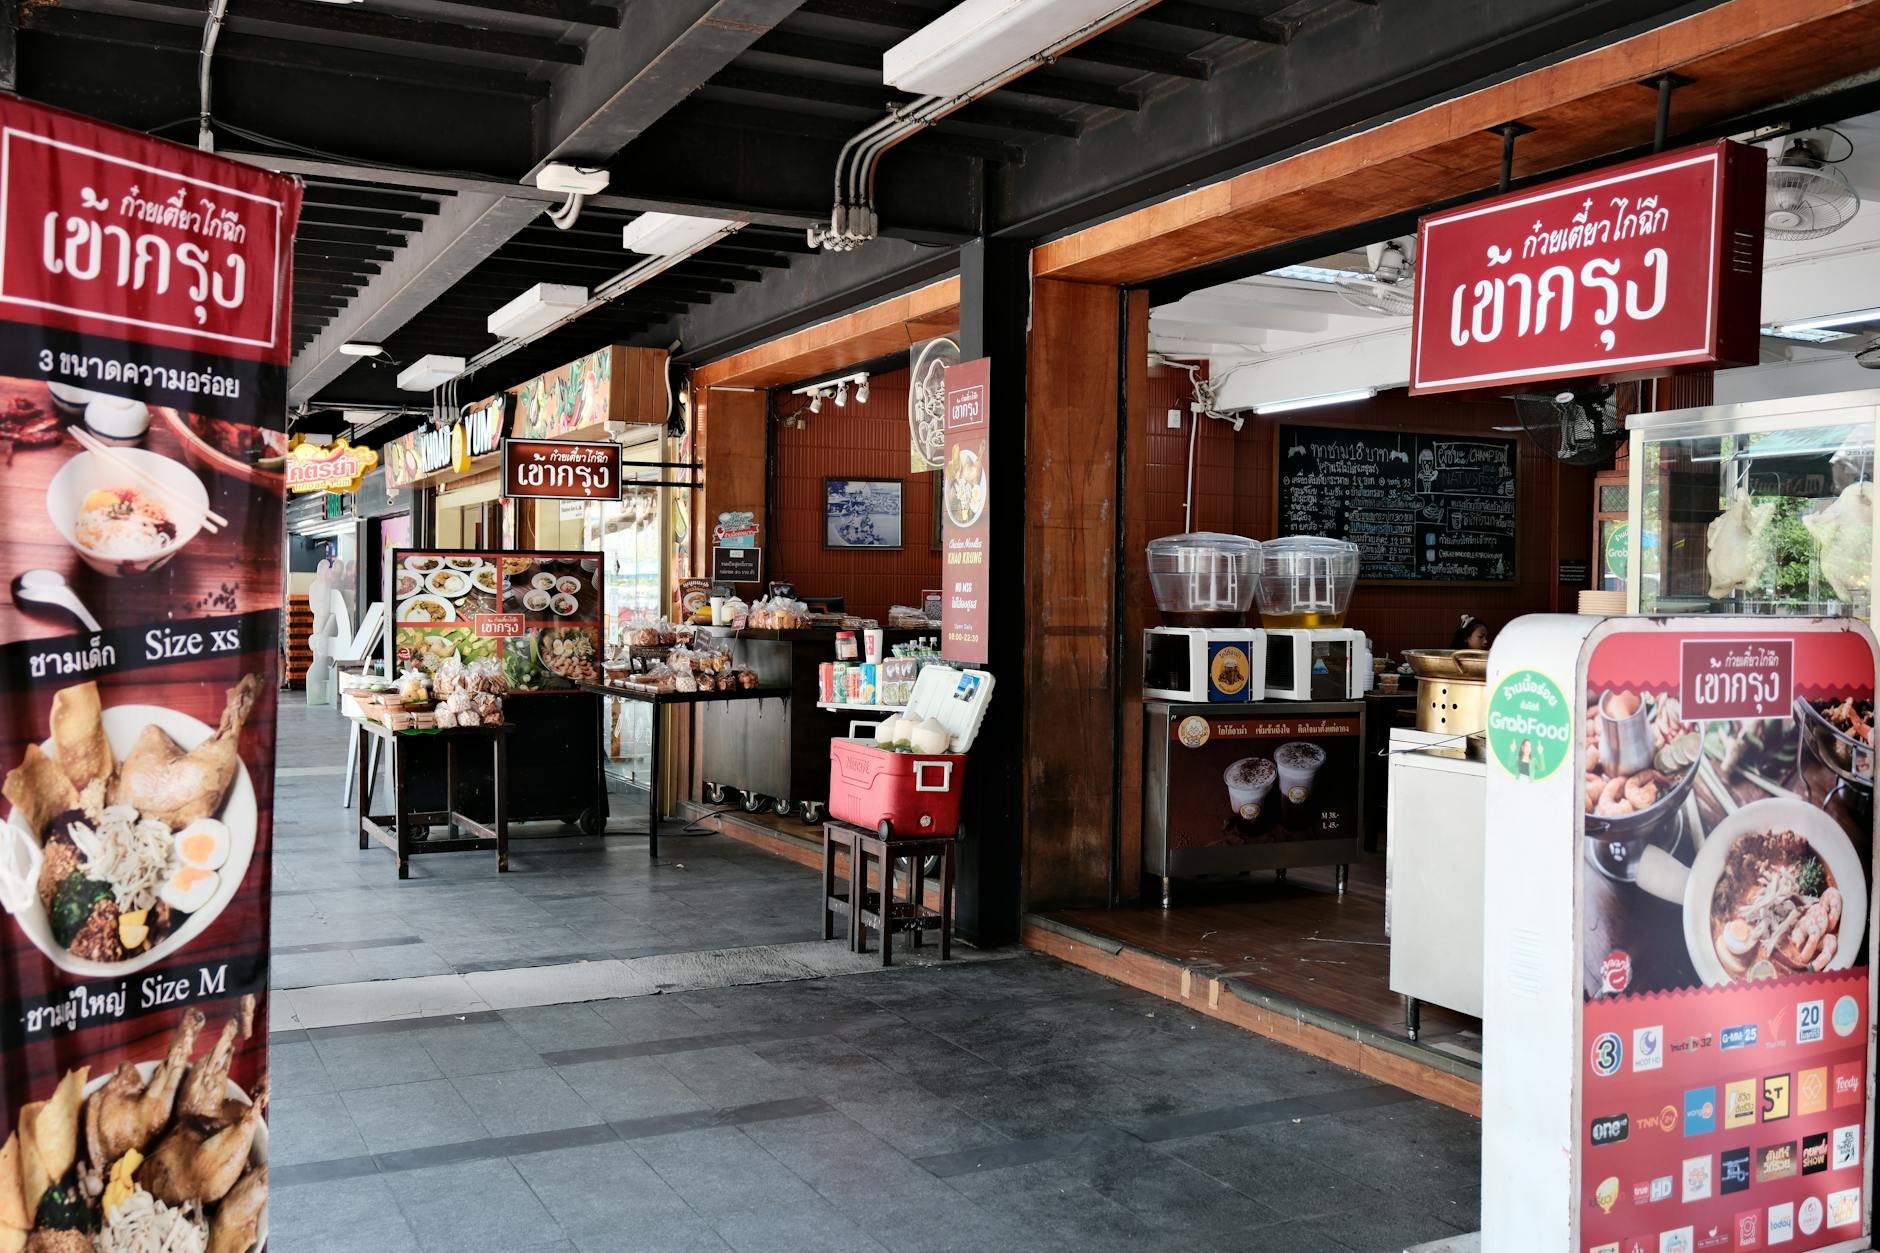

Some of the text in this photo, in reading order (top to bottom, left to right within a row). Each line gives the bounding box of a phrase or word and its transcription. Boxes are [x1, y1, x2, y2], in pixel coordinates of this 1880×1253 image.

[119, 185, 246, 244] ก๋วยเตี๋ยวไก่ฉีก
[1523, 194, 1669, 259] ก๋วยเตี๋ยวไก่ฉีก
[43, 187, 246, 325] เข้ากรุง
[1450, 245, 1669, 352] เข้ากรุง
[39, 349, 240, 398] 3 ขนาดความอร่อย
[420, 407, 495, 473] KHOAD YUM
[517, 452, 610, 495] เข้ากรุง
[962, 551, 982, 564] KRUNG
[481, 619, 519, 636] เข้ากรุง
[29, 635, 116, 678] ชามเด็ก
[145, 627, 203, 660] Size
[1503, 673, 1559, 707] ร้านนี้อร่อย
[1695, 657, 1780, 714] เข้ากรุง
[1490, 711, 1570, 742] GrabFood
[26, 965, 228, 1032] ชามผู้ใหญ่ Size M
[1801, 1005, 1820, 1027] 20
[1701, 1037, 1713, 1049] 32
[1744, 1028, 1757, 1041] 25
[1598, 1039, 1616, 1069] 3
[1592, 1120, 1620, 1140] one
[1637, 1117, 1659, 1129] TNN
[1803, 1156, 1825, 1168] SHOW
[1634, 1181, 1672, 1200] true HD
